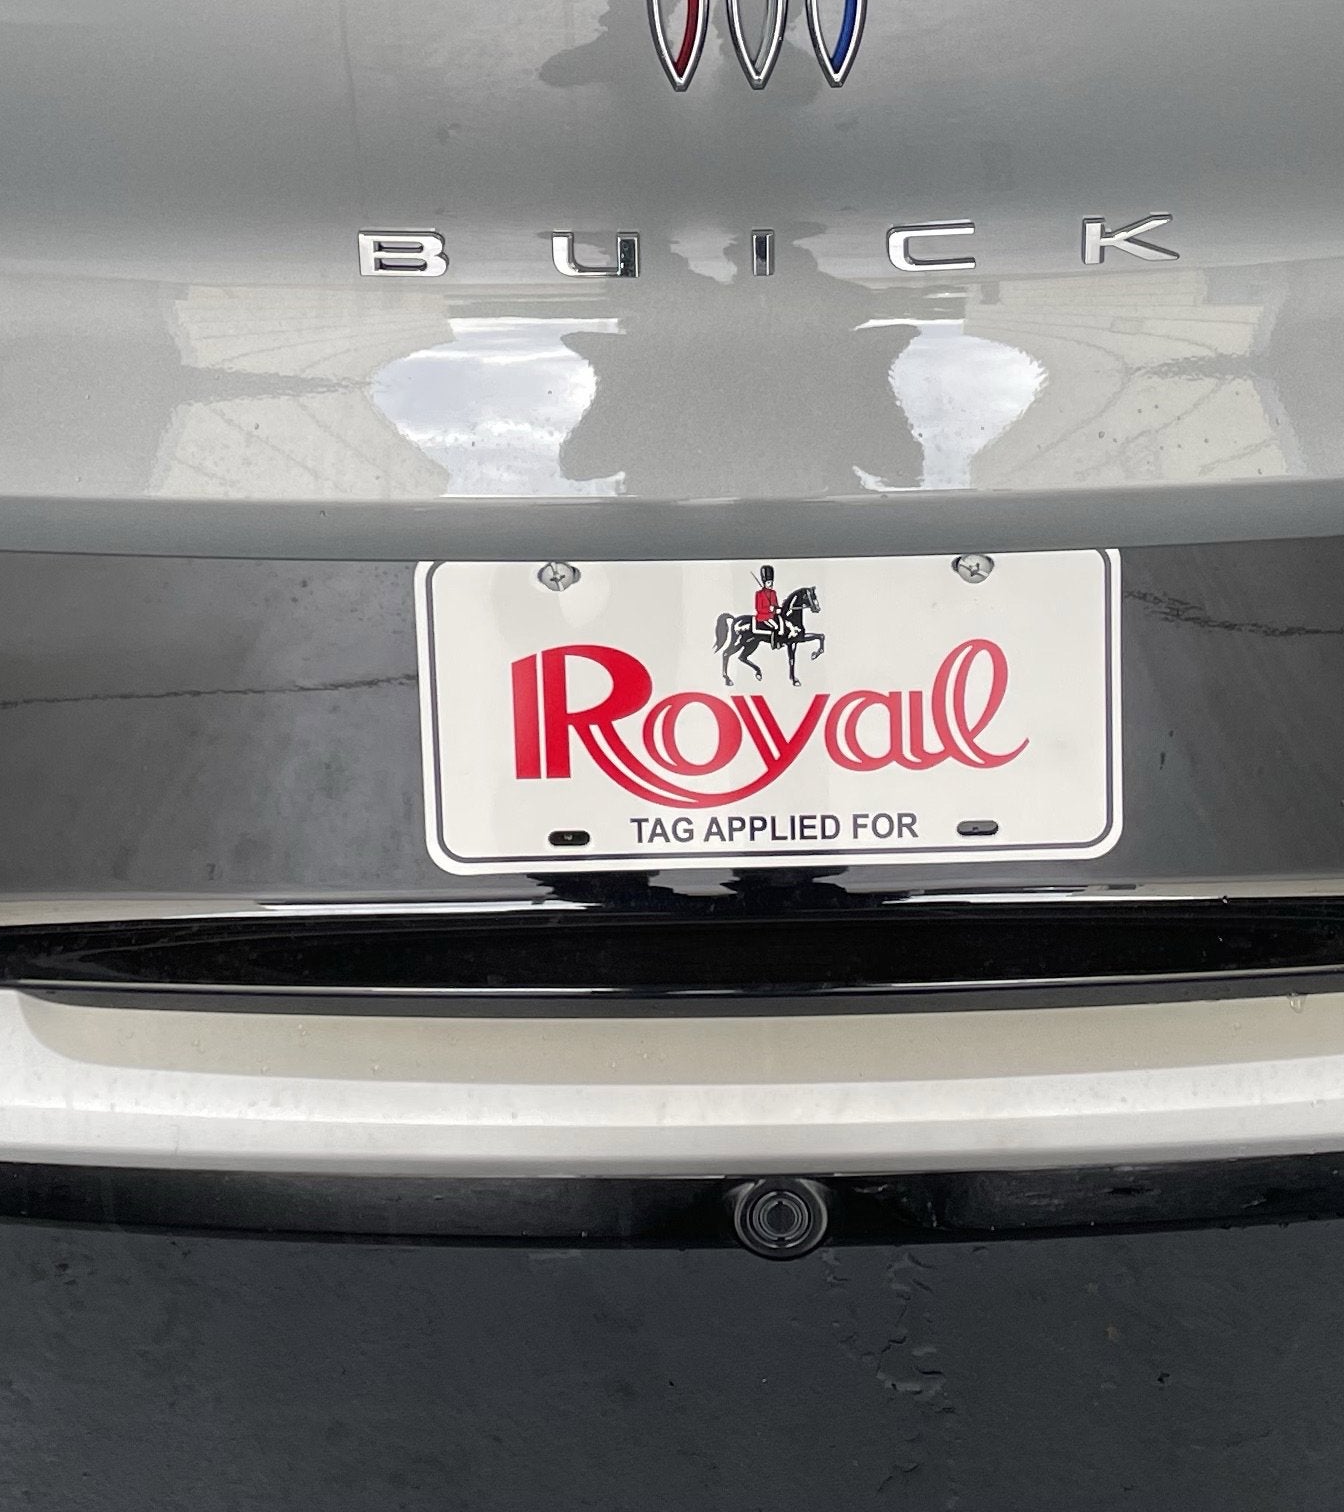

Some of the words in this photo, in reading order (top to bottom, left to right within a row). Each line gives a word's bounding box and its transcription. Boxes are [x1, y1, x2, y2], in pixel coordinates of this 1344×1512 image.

[358, 214, 1181, 278] BUICK
[511, 638, 1030, 808] Royal
[629, 817, 694, 844] TAG
[703, 814, 841, 842] APPLIED
[852, 812, 919, 839] FOR
